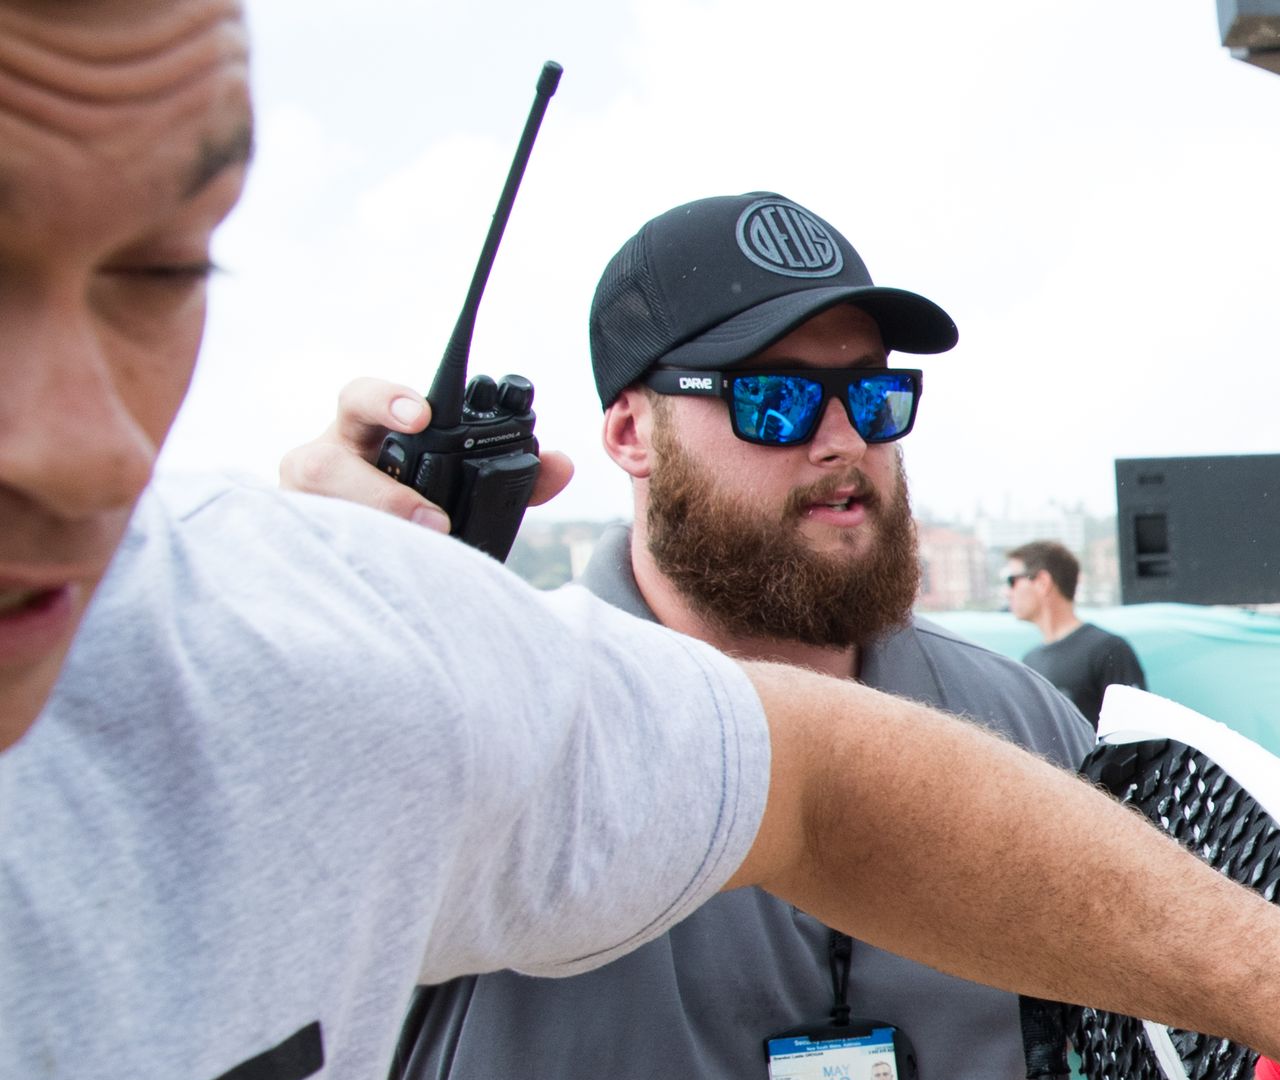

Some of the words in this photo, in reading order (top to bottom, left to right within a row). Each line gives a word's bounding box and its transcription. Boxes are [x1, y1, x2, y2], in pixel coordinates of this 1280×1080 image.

[749, 204, 831, 268] DEUS
[476, 431, 521, 445] MOTOROLA
[822, 1064, 850, 1078] MAY
